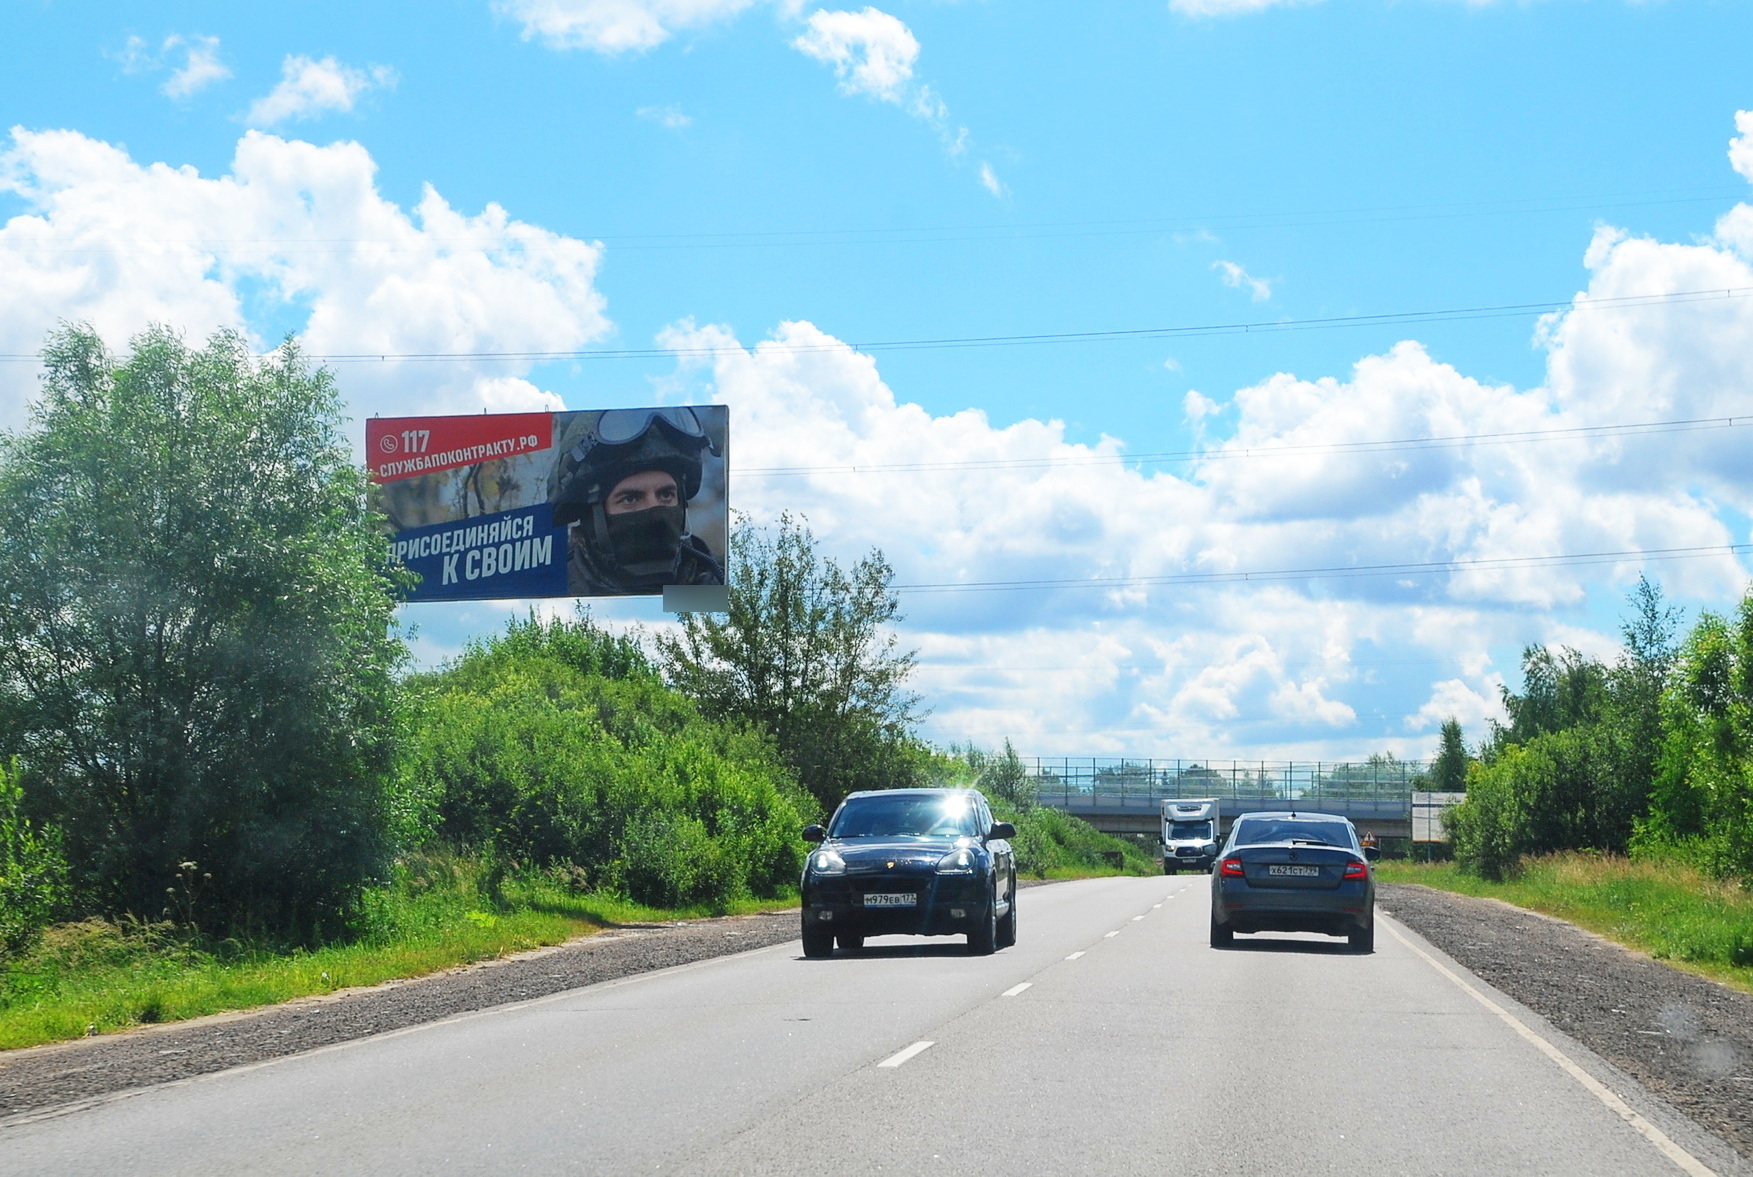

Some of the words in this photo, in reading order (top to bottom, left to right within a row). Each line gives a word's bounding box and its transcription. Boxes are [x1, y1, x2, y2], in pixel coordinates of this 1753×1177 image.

[380, 435, 538, 478] СЛУЖБАПОКОНТРАКТУ.РФ
[402, 430, 430, 453] 117
[442, 555, 458, 586] К
[465, 535, 553, 581] СВОИМ
